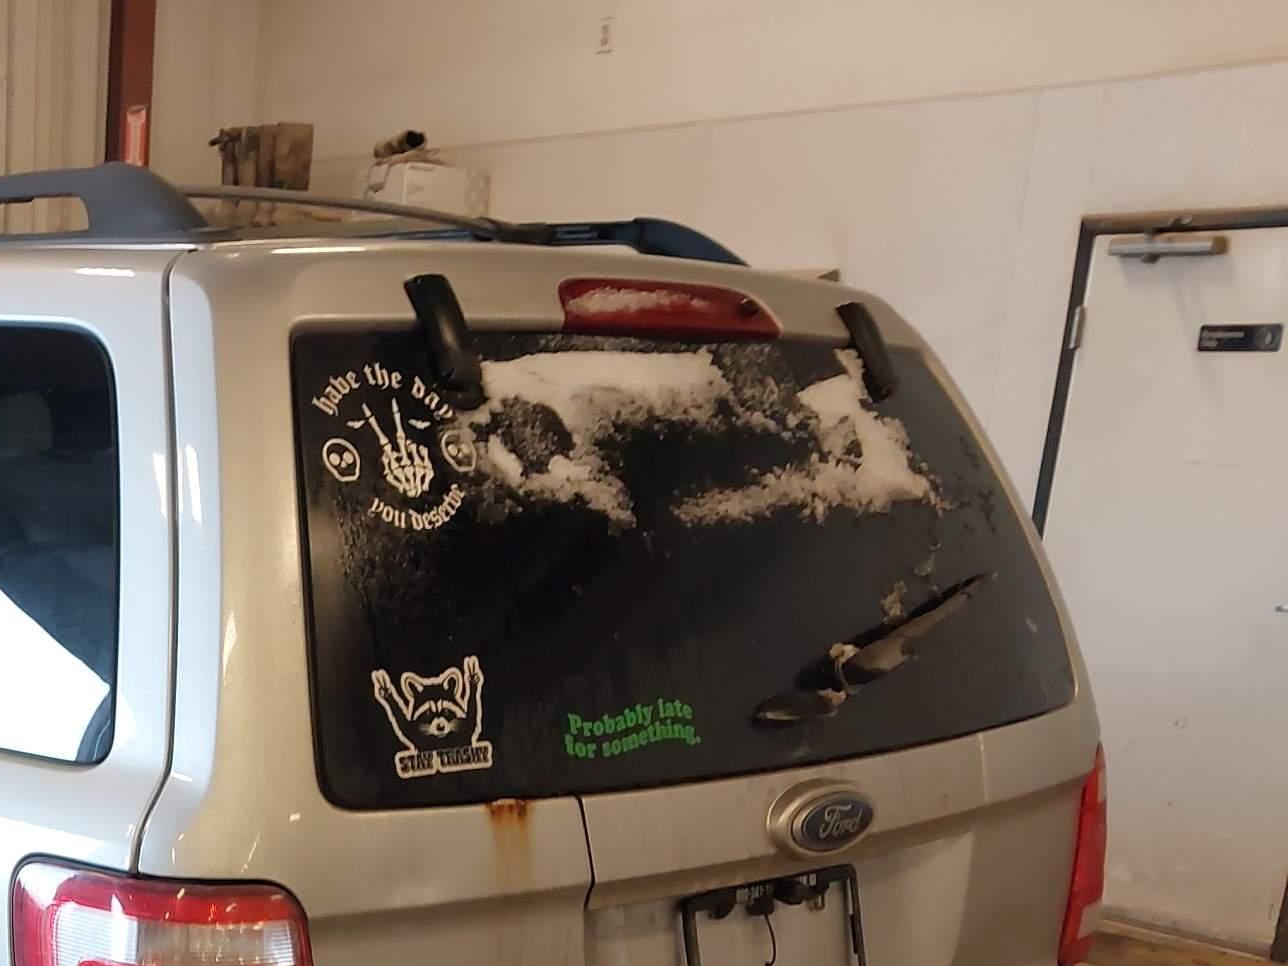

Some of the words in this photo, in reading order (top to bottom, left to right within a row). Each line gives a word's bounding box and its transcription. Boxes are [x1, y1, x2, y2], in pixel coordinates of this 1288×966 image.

[311, 370, 361, 417] have
[363, 361, 403, 391] the
[411, 375, 455, 421] day
[368, 497, 406, 529] you
[408, 483, 466, 531] deserve
[567, 703, 653, 737] Probably
[657, 697, 692, 720] late
[565, 733, 597, 759] for
[602, 719, 701, 757] something.
[399, 751, 434, 774] STAY
[439, 745, 489, 768] TRASHY
[819, 804, 864, 840] Ford
